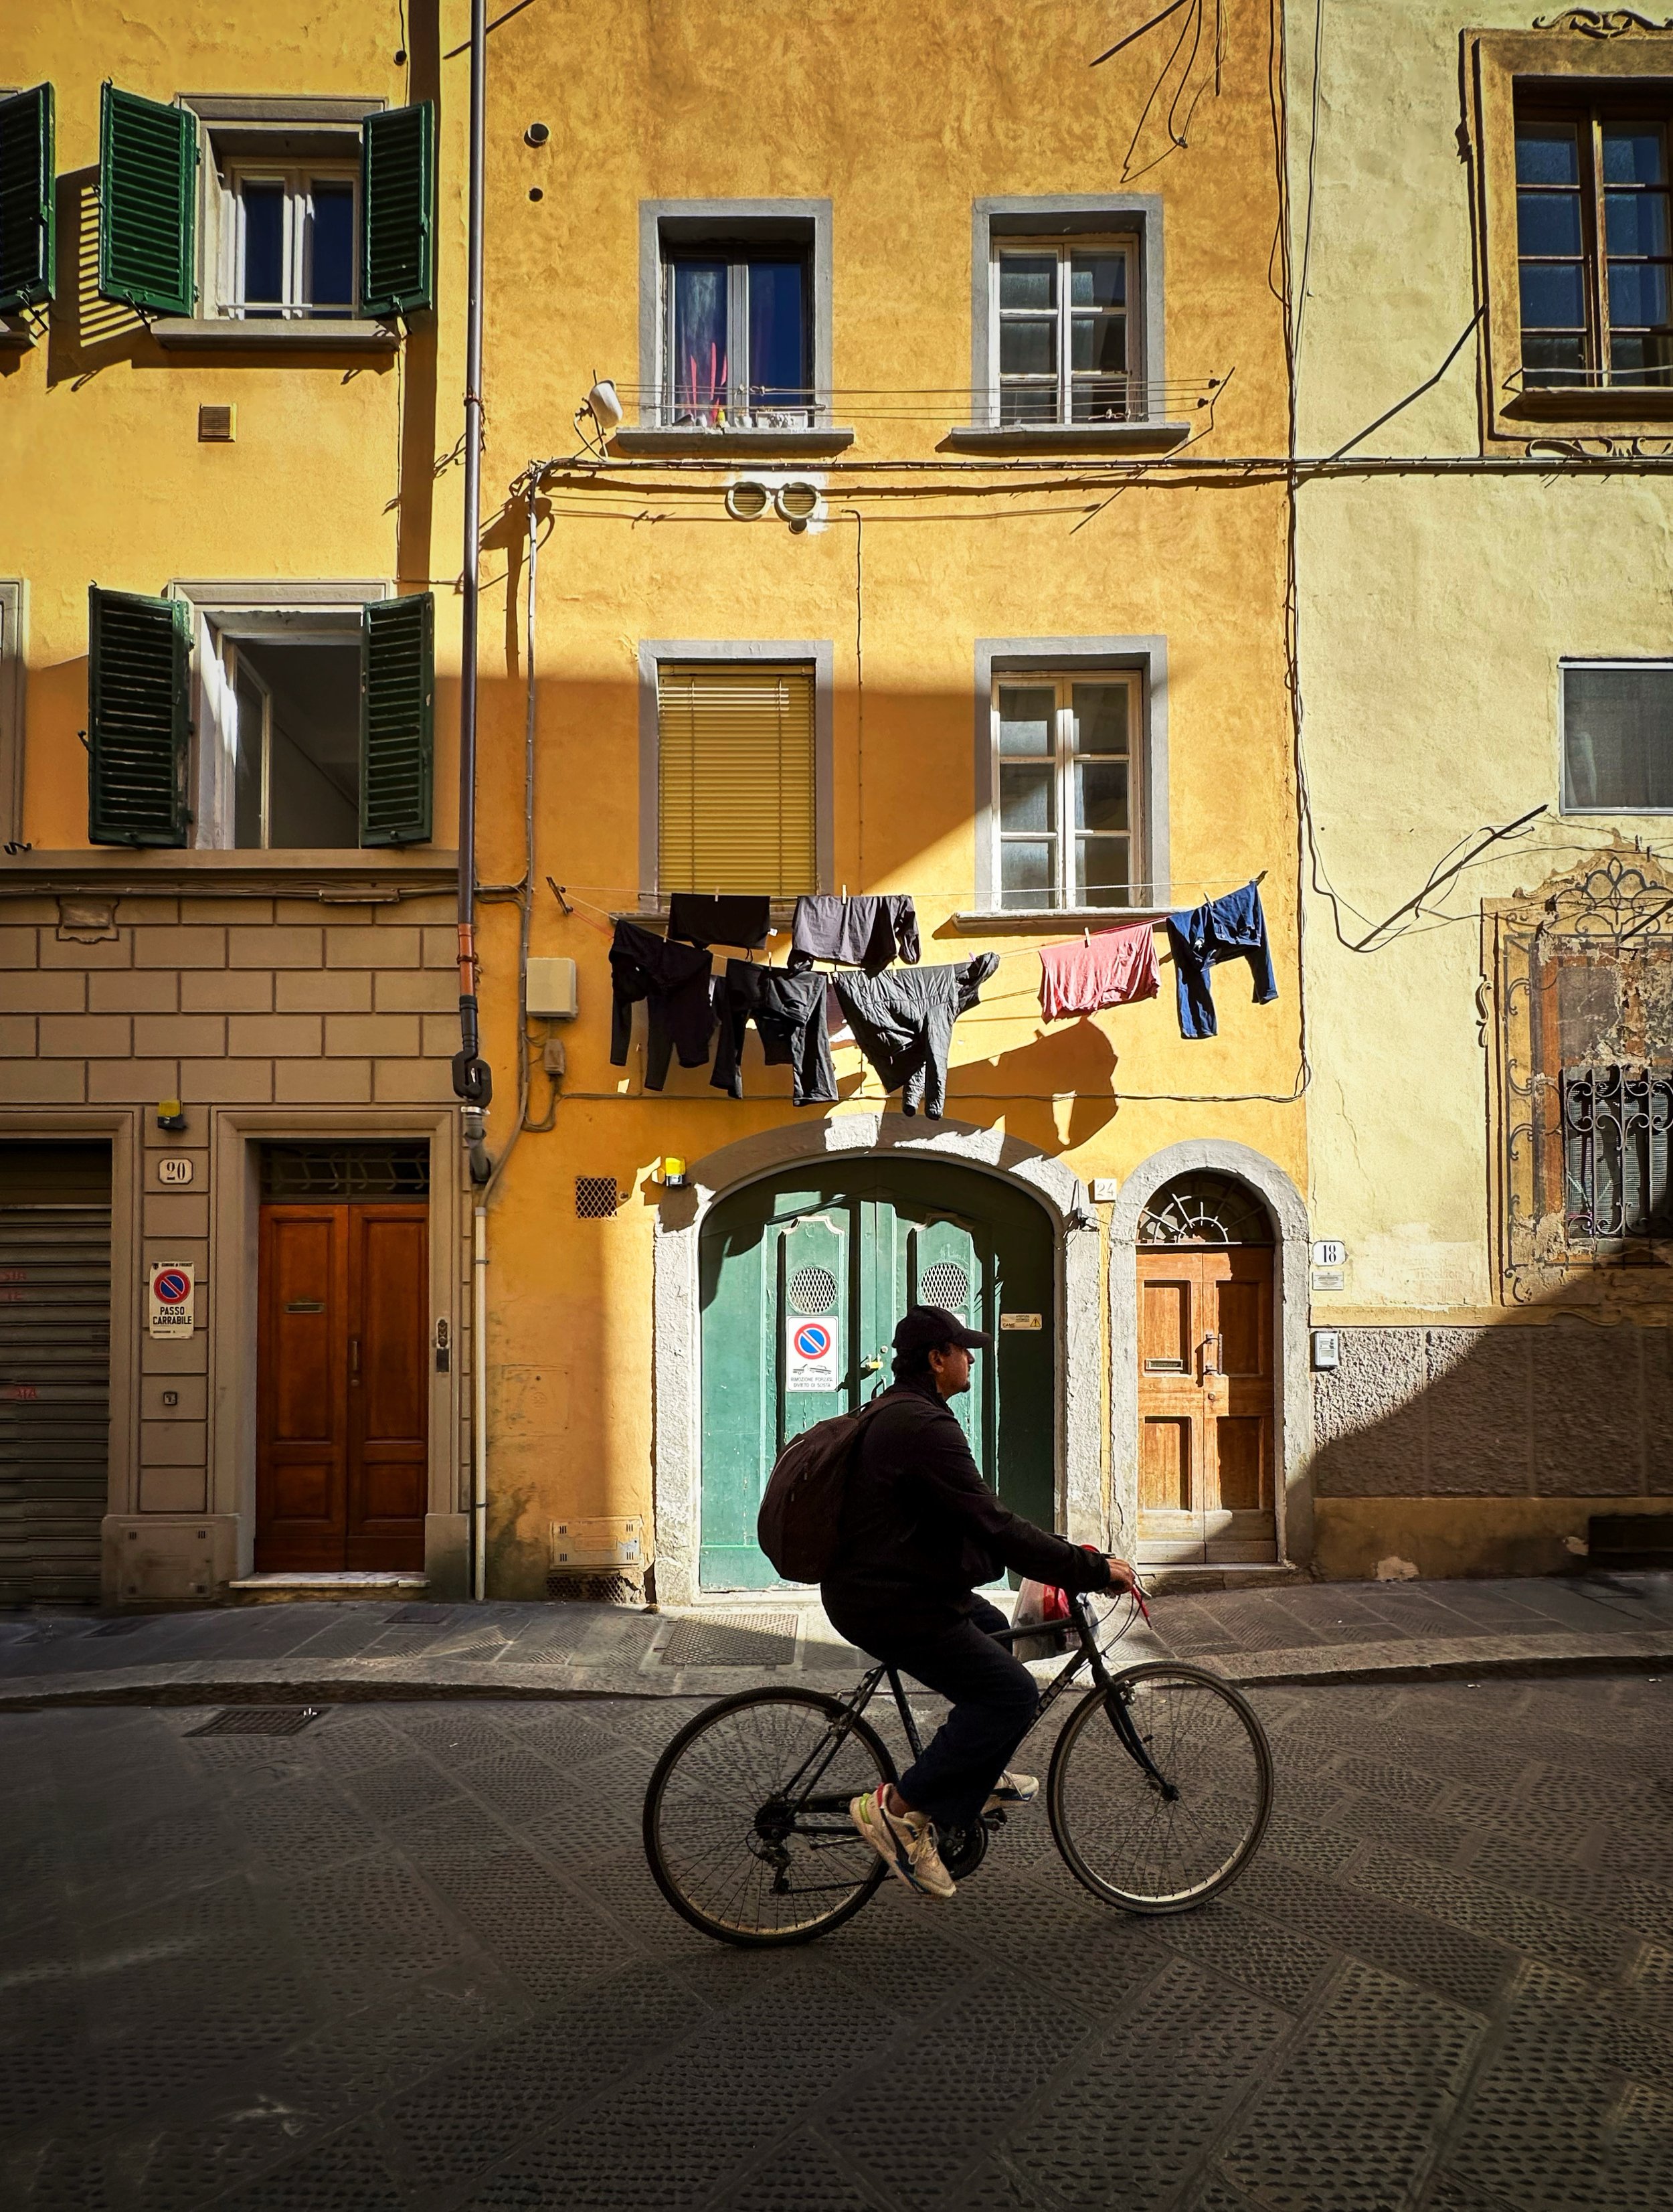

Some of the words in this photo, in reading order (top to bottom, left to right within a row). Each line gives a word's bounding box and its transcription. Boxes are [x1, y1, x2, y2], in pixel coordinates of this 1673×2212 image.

[167, 1161, 185, 1180] 20
[1097, 1183, 1114, 1197] 24
[1323, 1245, 1336, 1263] 18
[160, 1306, 185, 1315] PASSO
[153, 1316, 192, 1325] CARRABILE
[1035, 1673, 1070, 1715] TREK
